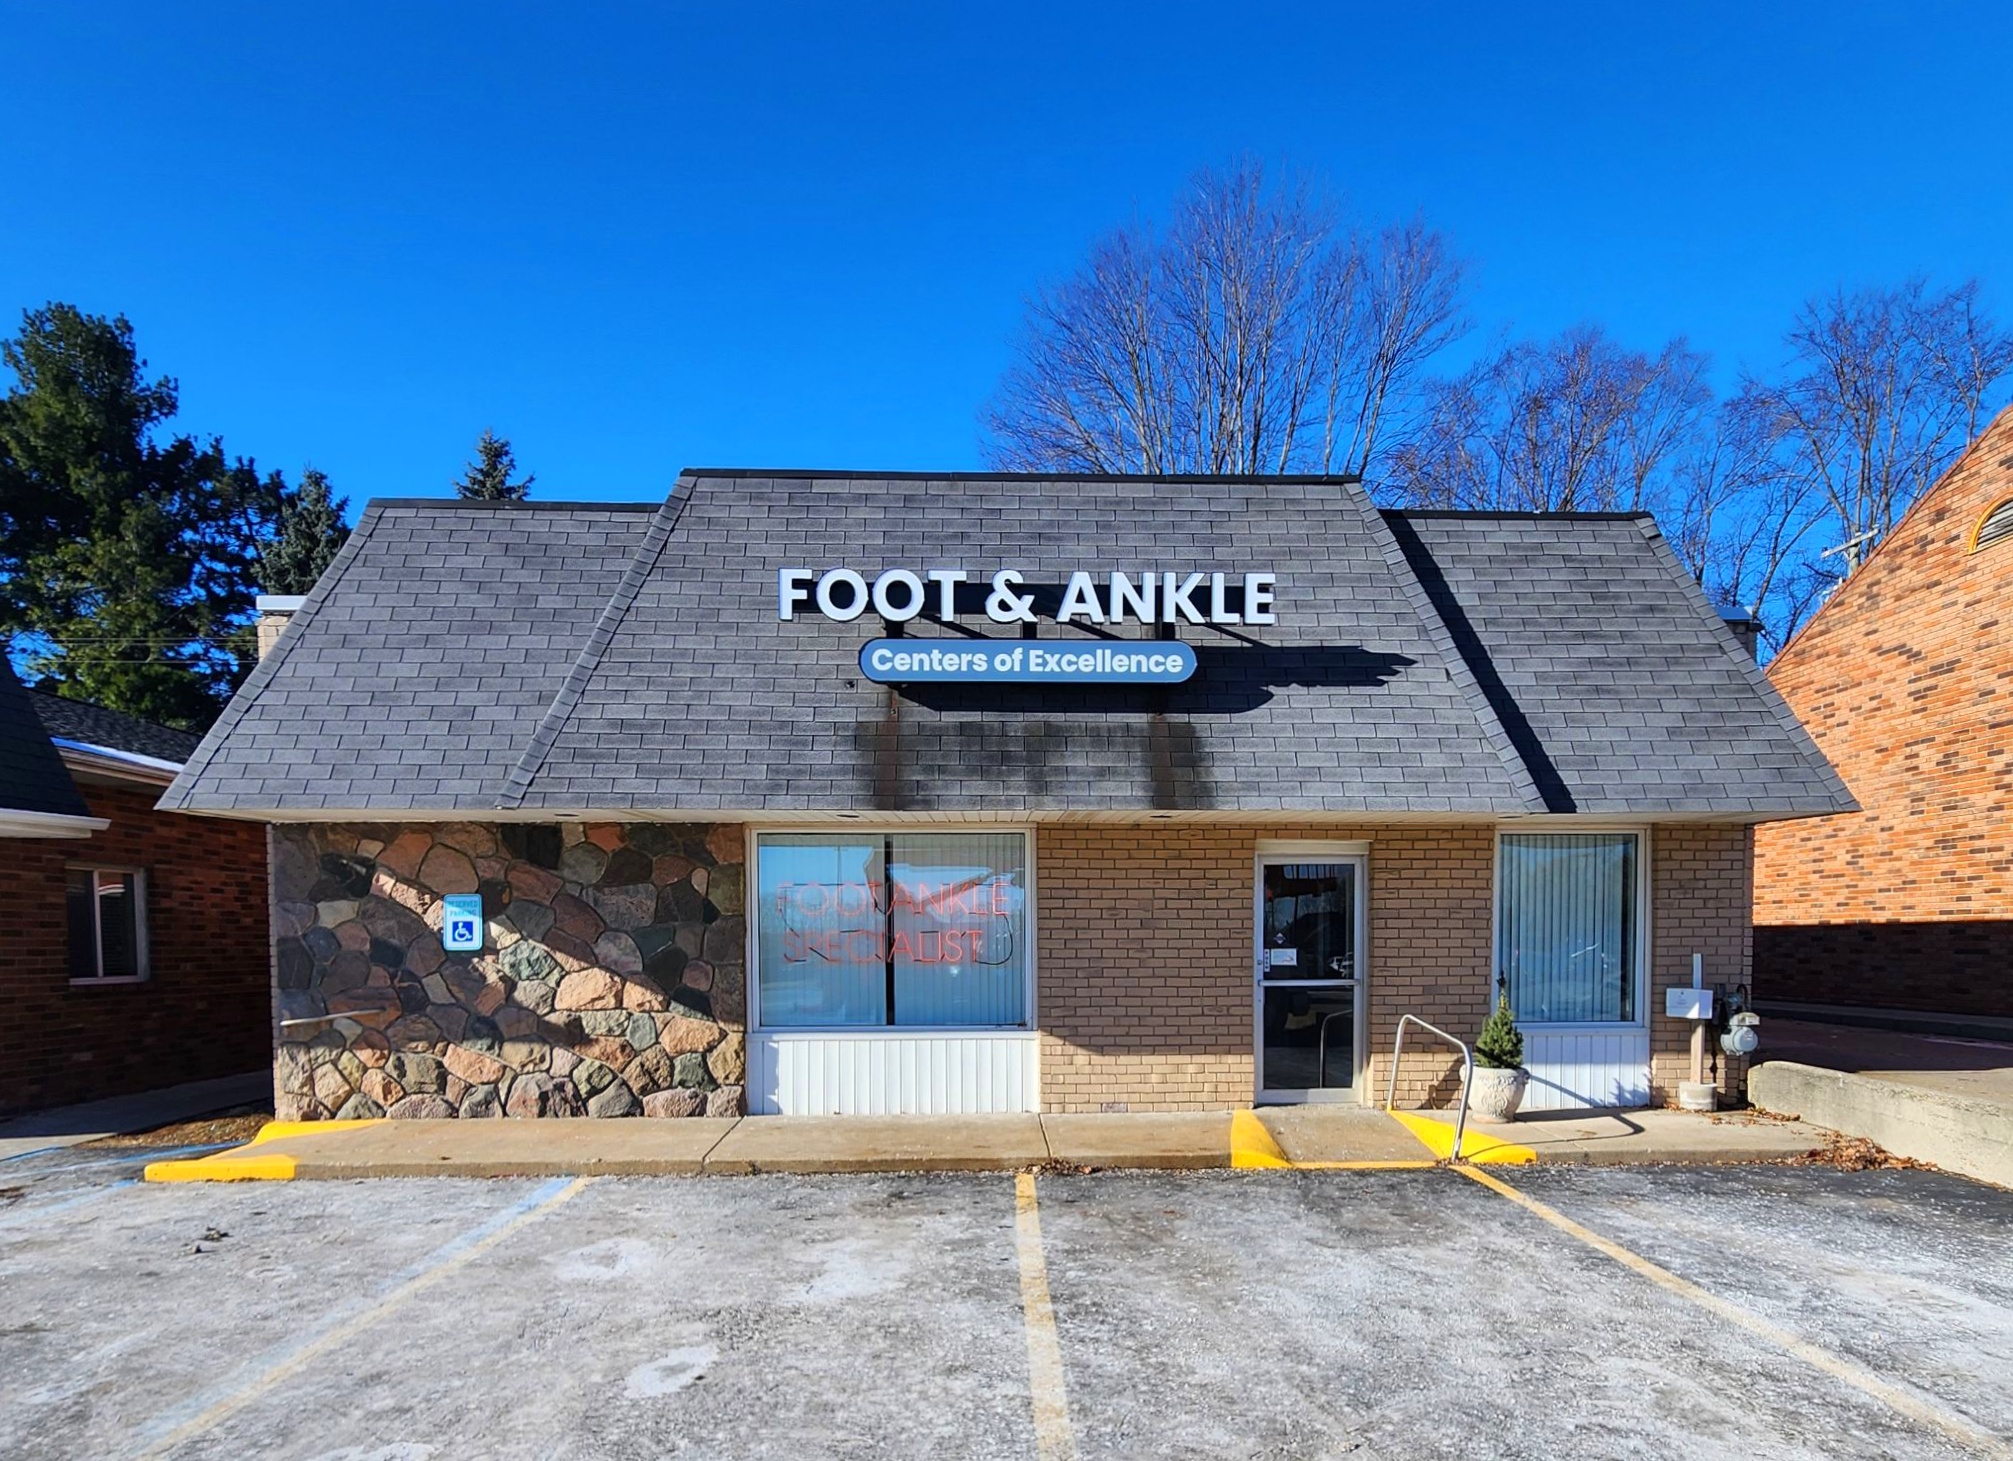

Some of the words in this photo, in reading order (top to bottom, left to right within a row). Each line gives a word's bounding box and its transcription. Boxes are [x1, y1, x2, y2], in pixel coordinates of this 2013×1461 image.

[778, 567, 967, 621] FOOT
[984, 569, 1038, 623] &
[1056, 571, 1276, 625] ANKLE
[871, 648, 988, 673] Centers
[993, 646, 1024, 673] of
[1028, 648, 1183, 674] Excellence
[775, 881, 883, 916] FOOT
[886, 881, 1009, 915] ANKLE
[783, 930, 983, 962] SPECIALIST
